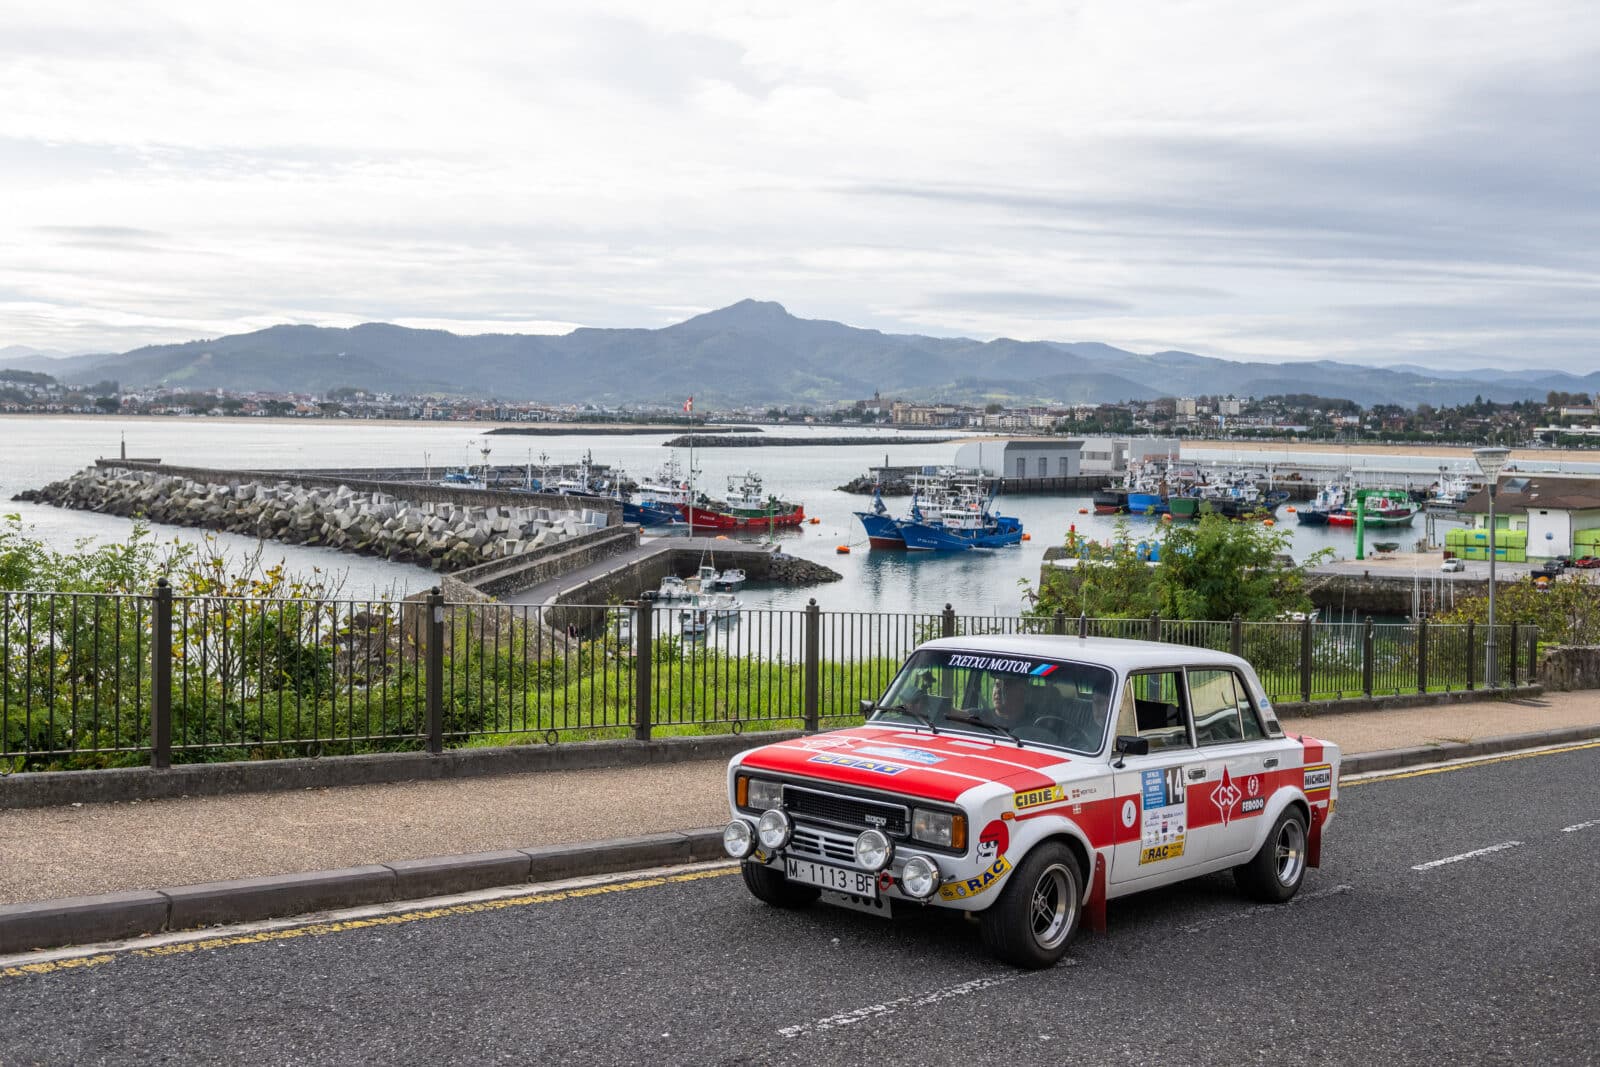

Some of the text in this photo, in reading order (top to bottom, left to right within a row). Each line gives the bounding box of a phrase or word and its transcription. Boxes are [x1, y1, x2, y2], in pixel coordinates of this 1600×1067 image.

[948, 654, 1032, 674] TXETXU MOTOR
[1166, 768, 1184, 804] 14
[1304, 772, 1330, 786] MICHELIN
[1219, 786, 1234, 806] CS
[1242, 798, 1264, 812] FERODO
[1126, 806, 1132, 822] 4
[1148, 845, 1169, 860] RAC
[966, 859, 1005, 891] RAC
